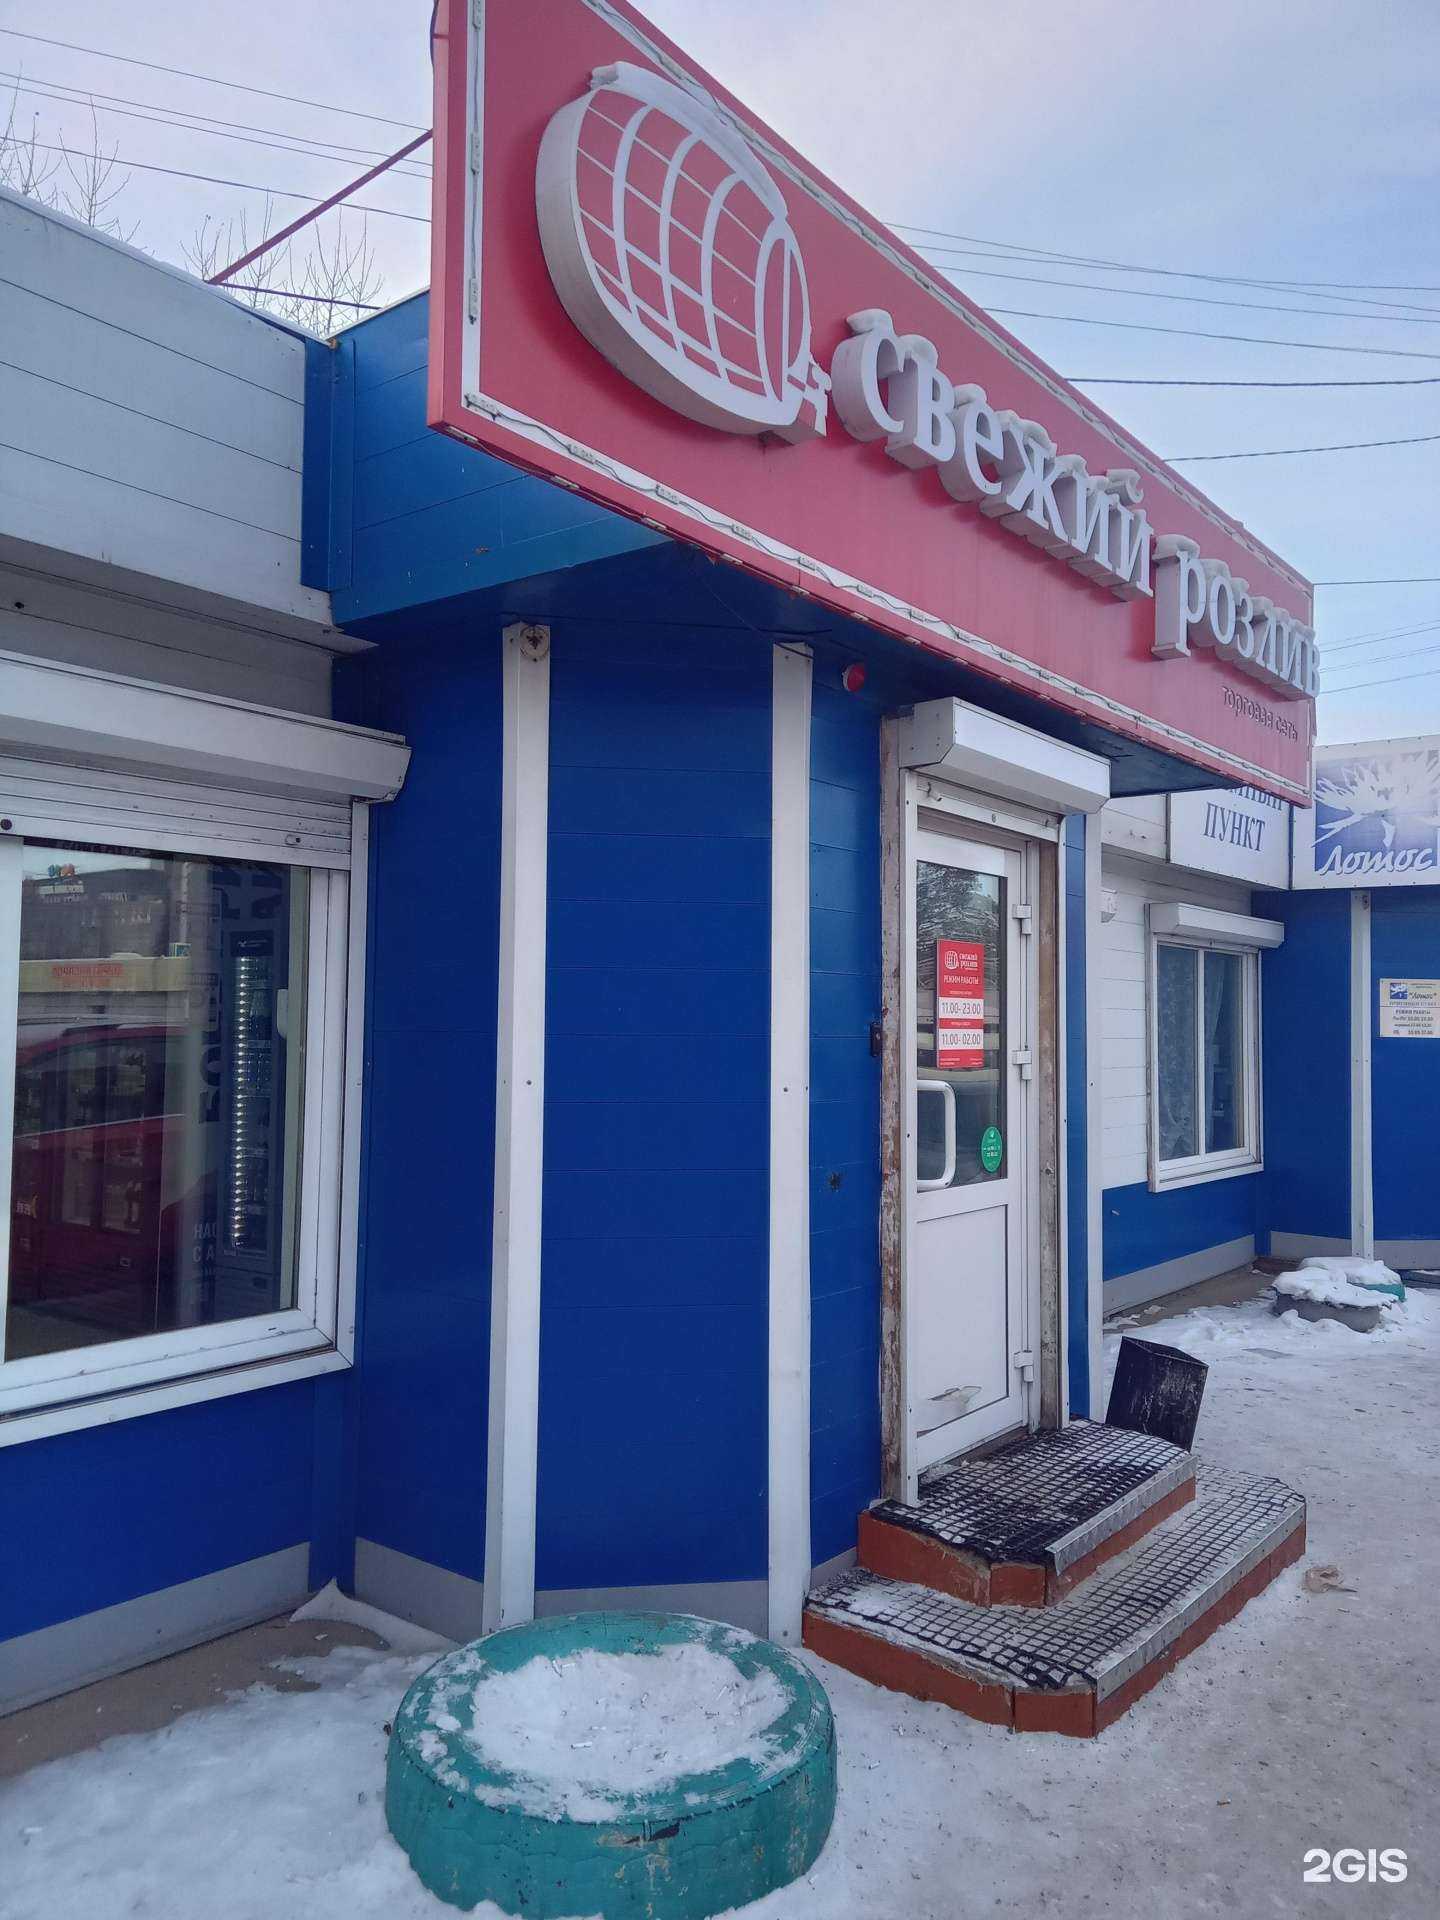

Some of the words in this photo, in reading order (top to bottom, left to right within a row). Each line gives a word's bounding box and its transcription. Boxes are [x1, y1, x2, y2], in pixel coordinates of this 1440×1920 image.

[1222, 686, 1274, 728] торговая
[1275, 716, 1298, 742] сеть
[1203, 801, 1266, 852] ПУНКТ
[1319, 845, 1433, 876] Лотос
